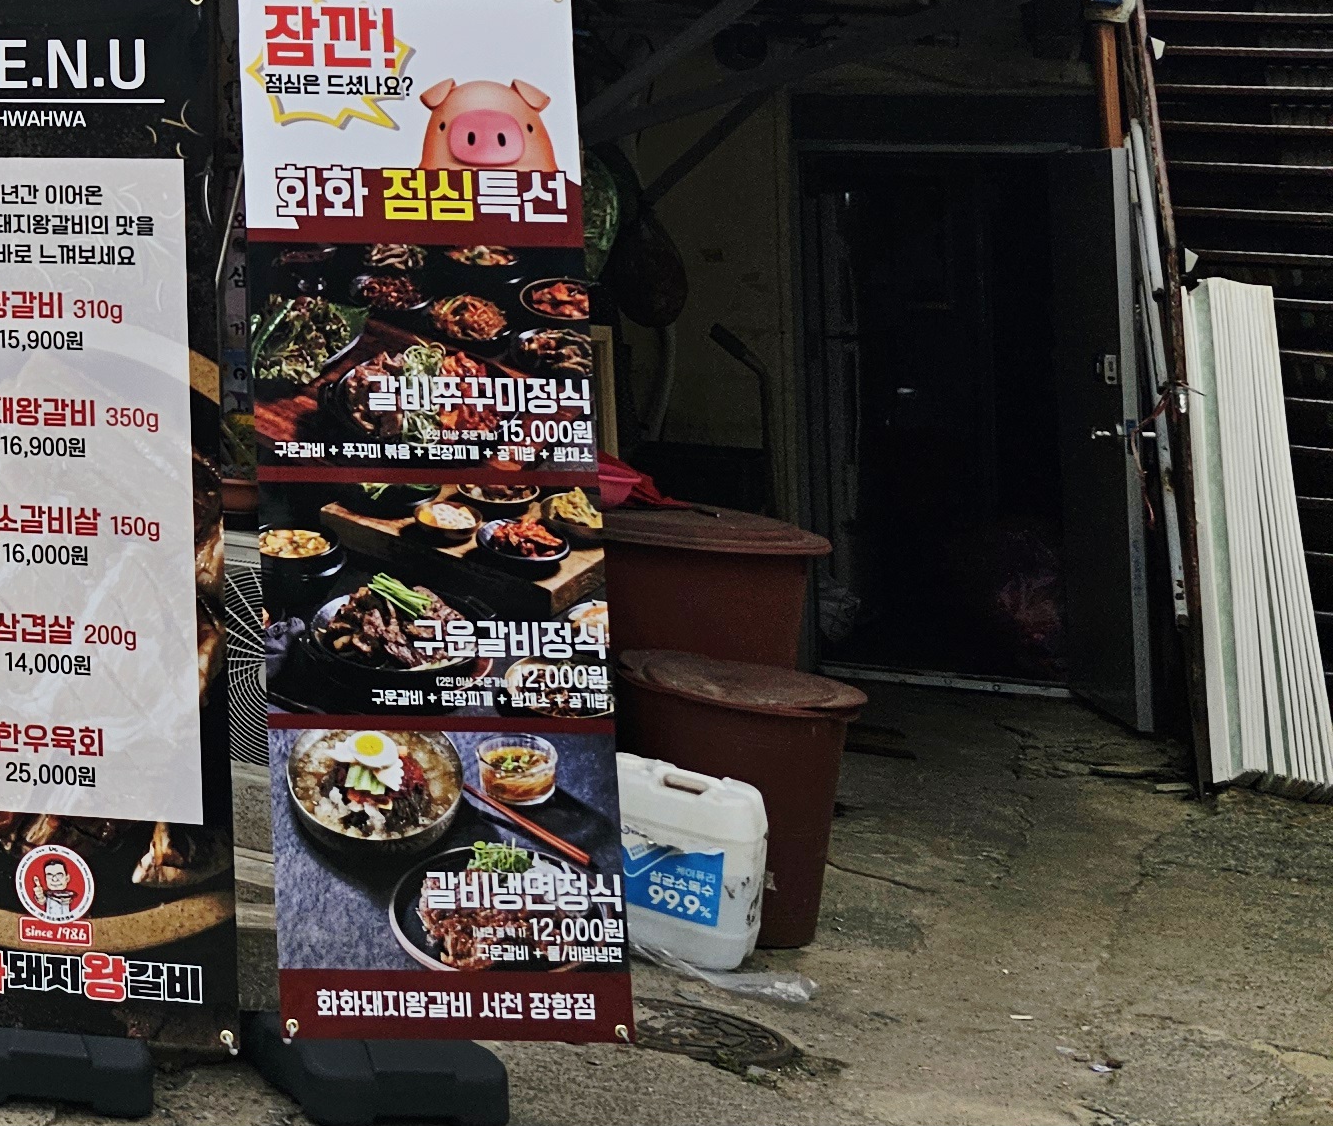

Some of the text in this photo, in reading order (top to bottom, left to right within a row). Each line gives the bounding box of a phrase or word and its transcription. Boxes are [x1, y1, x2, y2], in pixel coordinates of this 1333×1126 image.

[264, 5, 396, 69] 잠깐!
[265, 73, 414, 97] 점심은 드셨나요?
[45, 183, 104, 207] 이어온
[275, 163, 569, 224] 화화 점심특선
[115, 214, 155, 239] 맛을
[38, 244, 136, 268] 느껴보세요
[72, 299, 124, 325] 310g
[368, 375, 591, 415] 갈비쭈꾸미정식
[105, 407, 160, 433] 350g
[499, 420, 594, 445] 15,000원
[0, 435, 87, 460] 16,900원
[274, 441, 325, 458] 구운갈비
[110, 515, 161, 542] 150g
[2, 542, 89, 568] 16,000원
[84, 624, 138, 651] 200g
[413, 619, 607, 660] 구운갈비정식
[4, 651, 92, 677] 14,000원
[514, 665, 608, 690] 12,000원
[371, 689, 423, 706] 구운갈비
[5, 761, 97, 788] 25,000원
[426, 871, 623, 912] 갈비냉면정식
[648, 884, 712, 919] 99.9%
[25, 925, 88, 941] since 1986
[529, 917, 624, 945] 12,000원
[476, 944, 529, 961] 구운갈비
[316, 987, 597, 1021] 화화돼지왕갈비 서천 장항점
